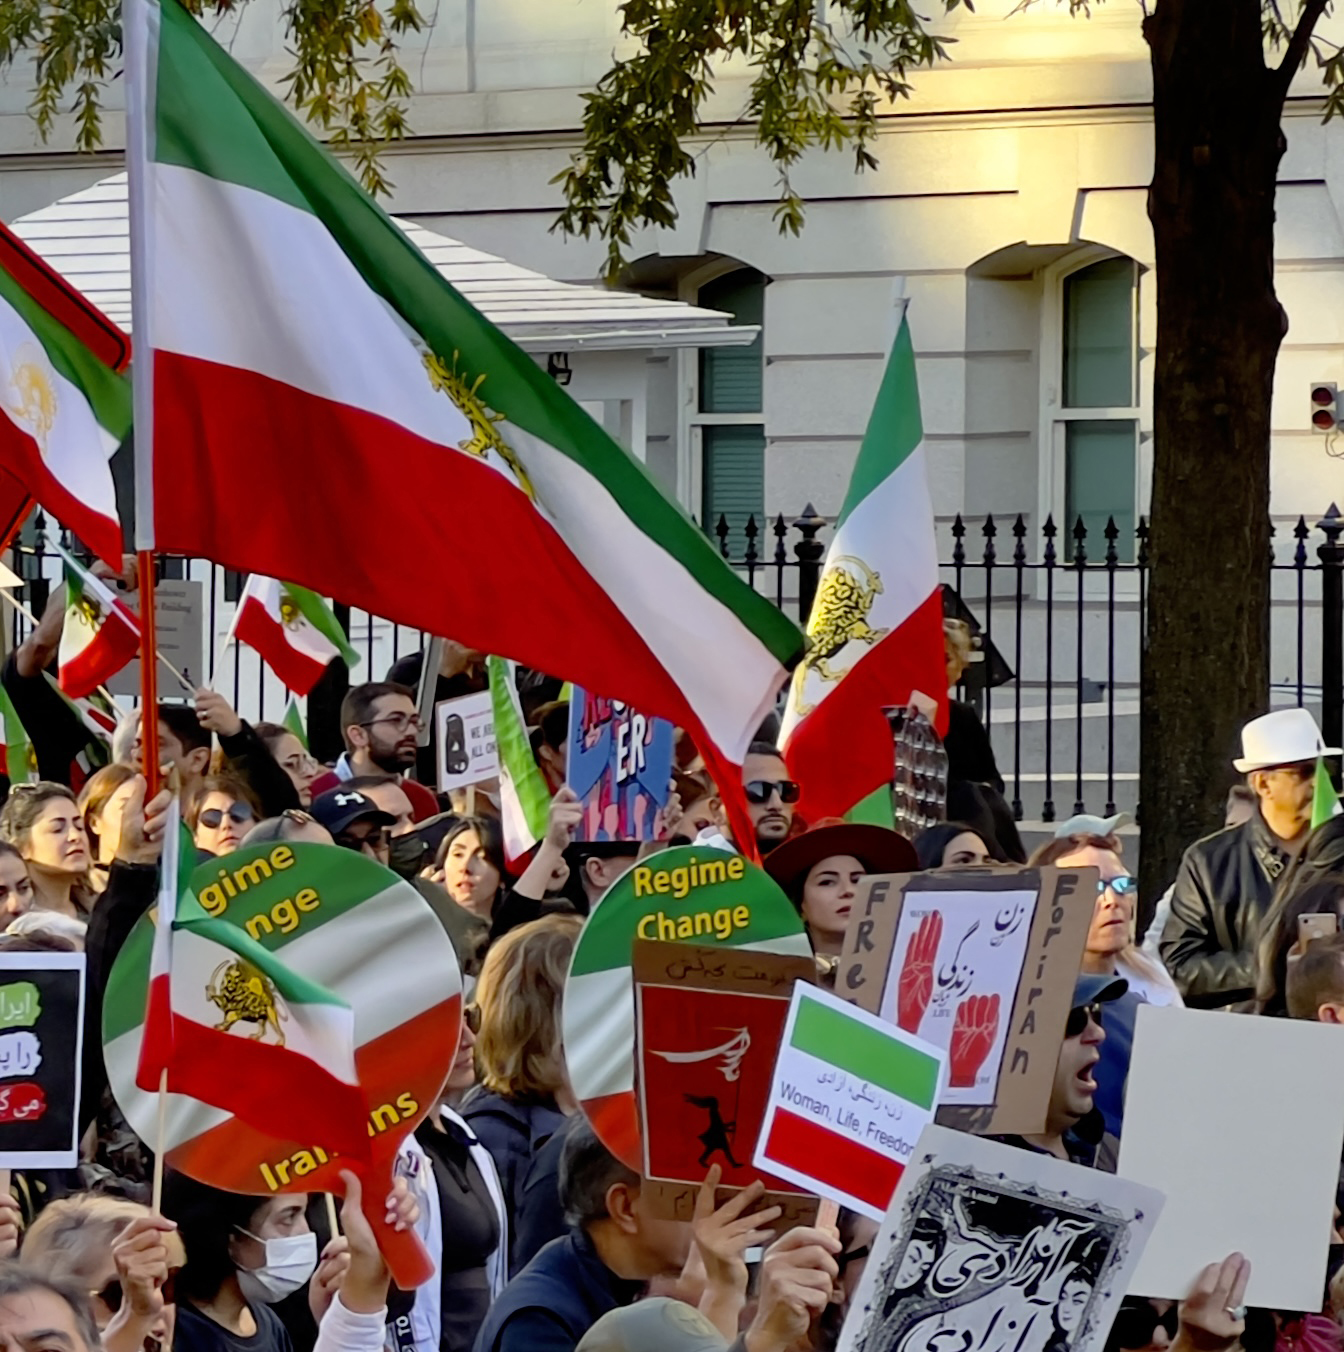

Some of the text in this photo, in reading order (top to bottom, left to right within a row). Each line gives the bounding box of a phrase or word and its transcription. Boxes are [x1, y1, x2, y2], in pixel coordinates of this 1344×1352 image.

[199, 843, 296, 916] gime
[634, 857, 745, 899] Regime
[245, 886, 321, 942] nge
[637, 905, 750, 940] Change
[15, 1041, 32, 1070] را
[12, 1098, 41, 1119] می
[779, 1080, 833, 1122] Woman,
[836, 1107, 864, 1137] Life,
